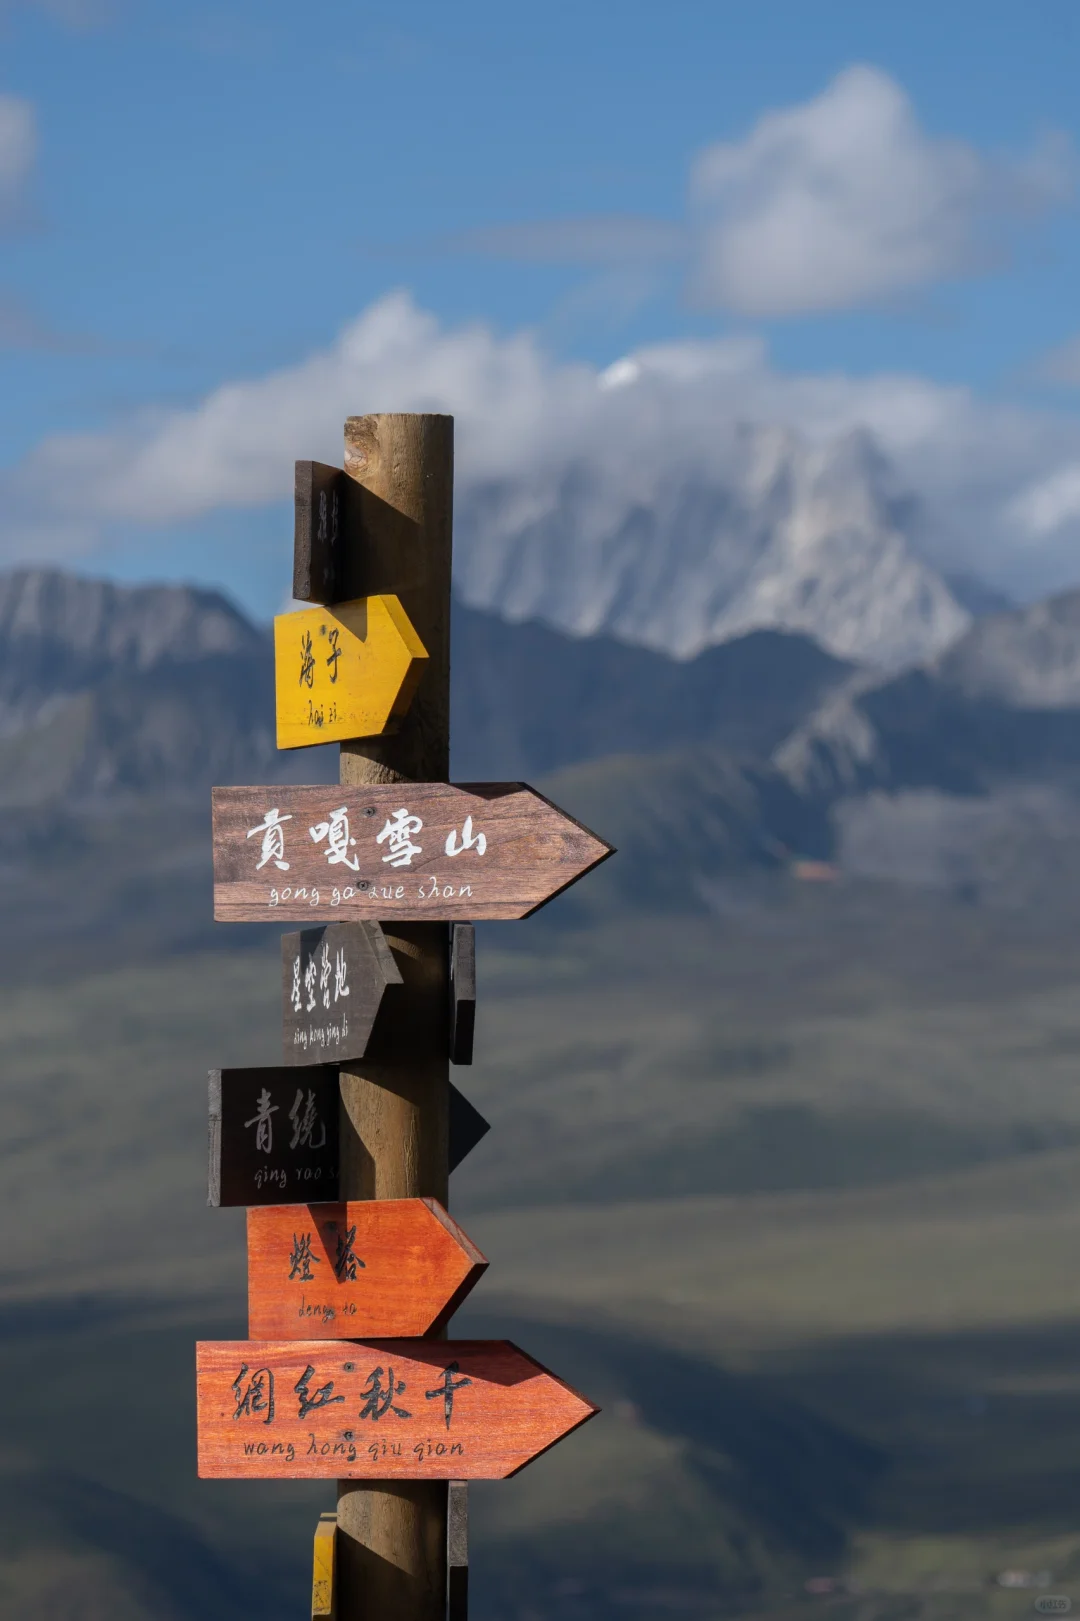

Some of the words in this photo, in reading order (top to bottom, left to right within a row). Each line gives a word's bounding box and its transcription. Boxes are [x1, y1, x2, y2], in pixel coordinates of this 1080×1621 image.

[299, 627, 342, 689] 海子
[268, 885, 320, 907] gong
[330, 885, 356, 906] ga
[417, 876, 474, 899] shan
[254, 1166, 288, 1189] qing
[295, 1166, 323, 1181] rao
[298, 1294, 335, 1323] deng
[341, 1302, 358, 1316] ta
[243, 1440, 296, 1461] wang
[305, 1433, 358, 1461] hong
[367, 1439, 403, 1461] qiu
[413, 1439, 465, 1461] qian
